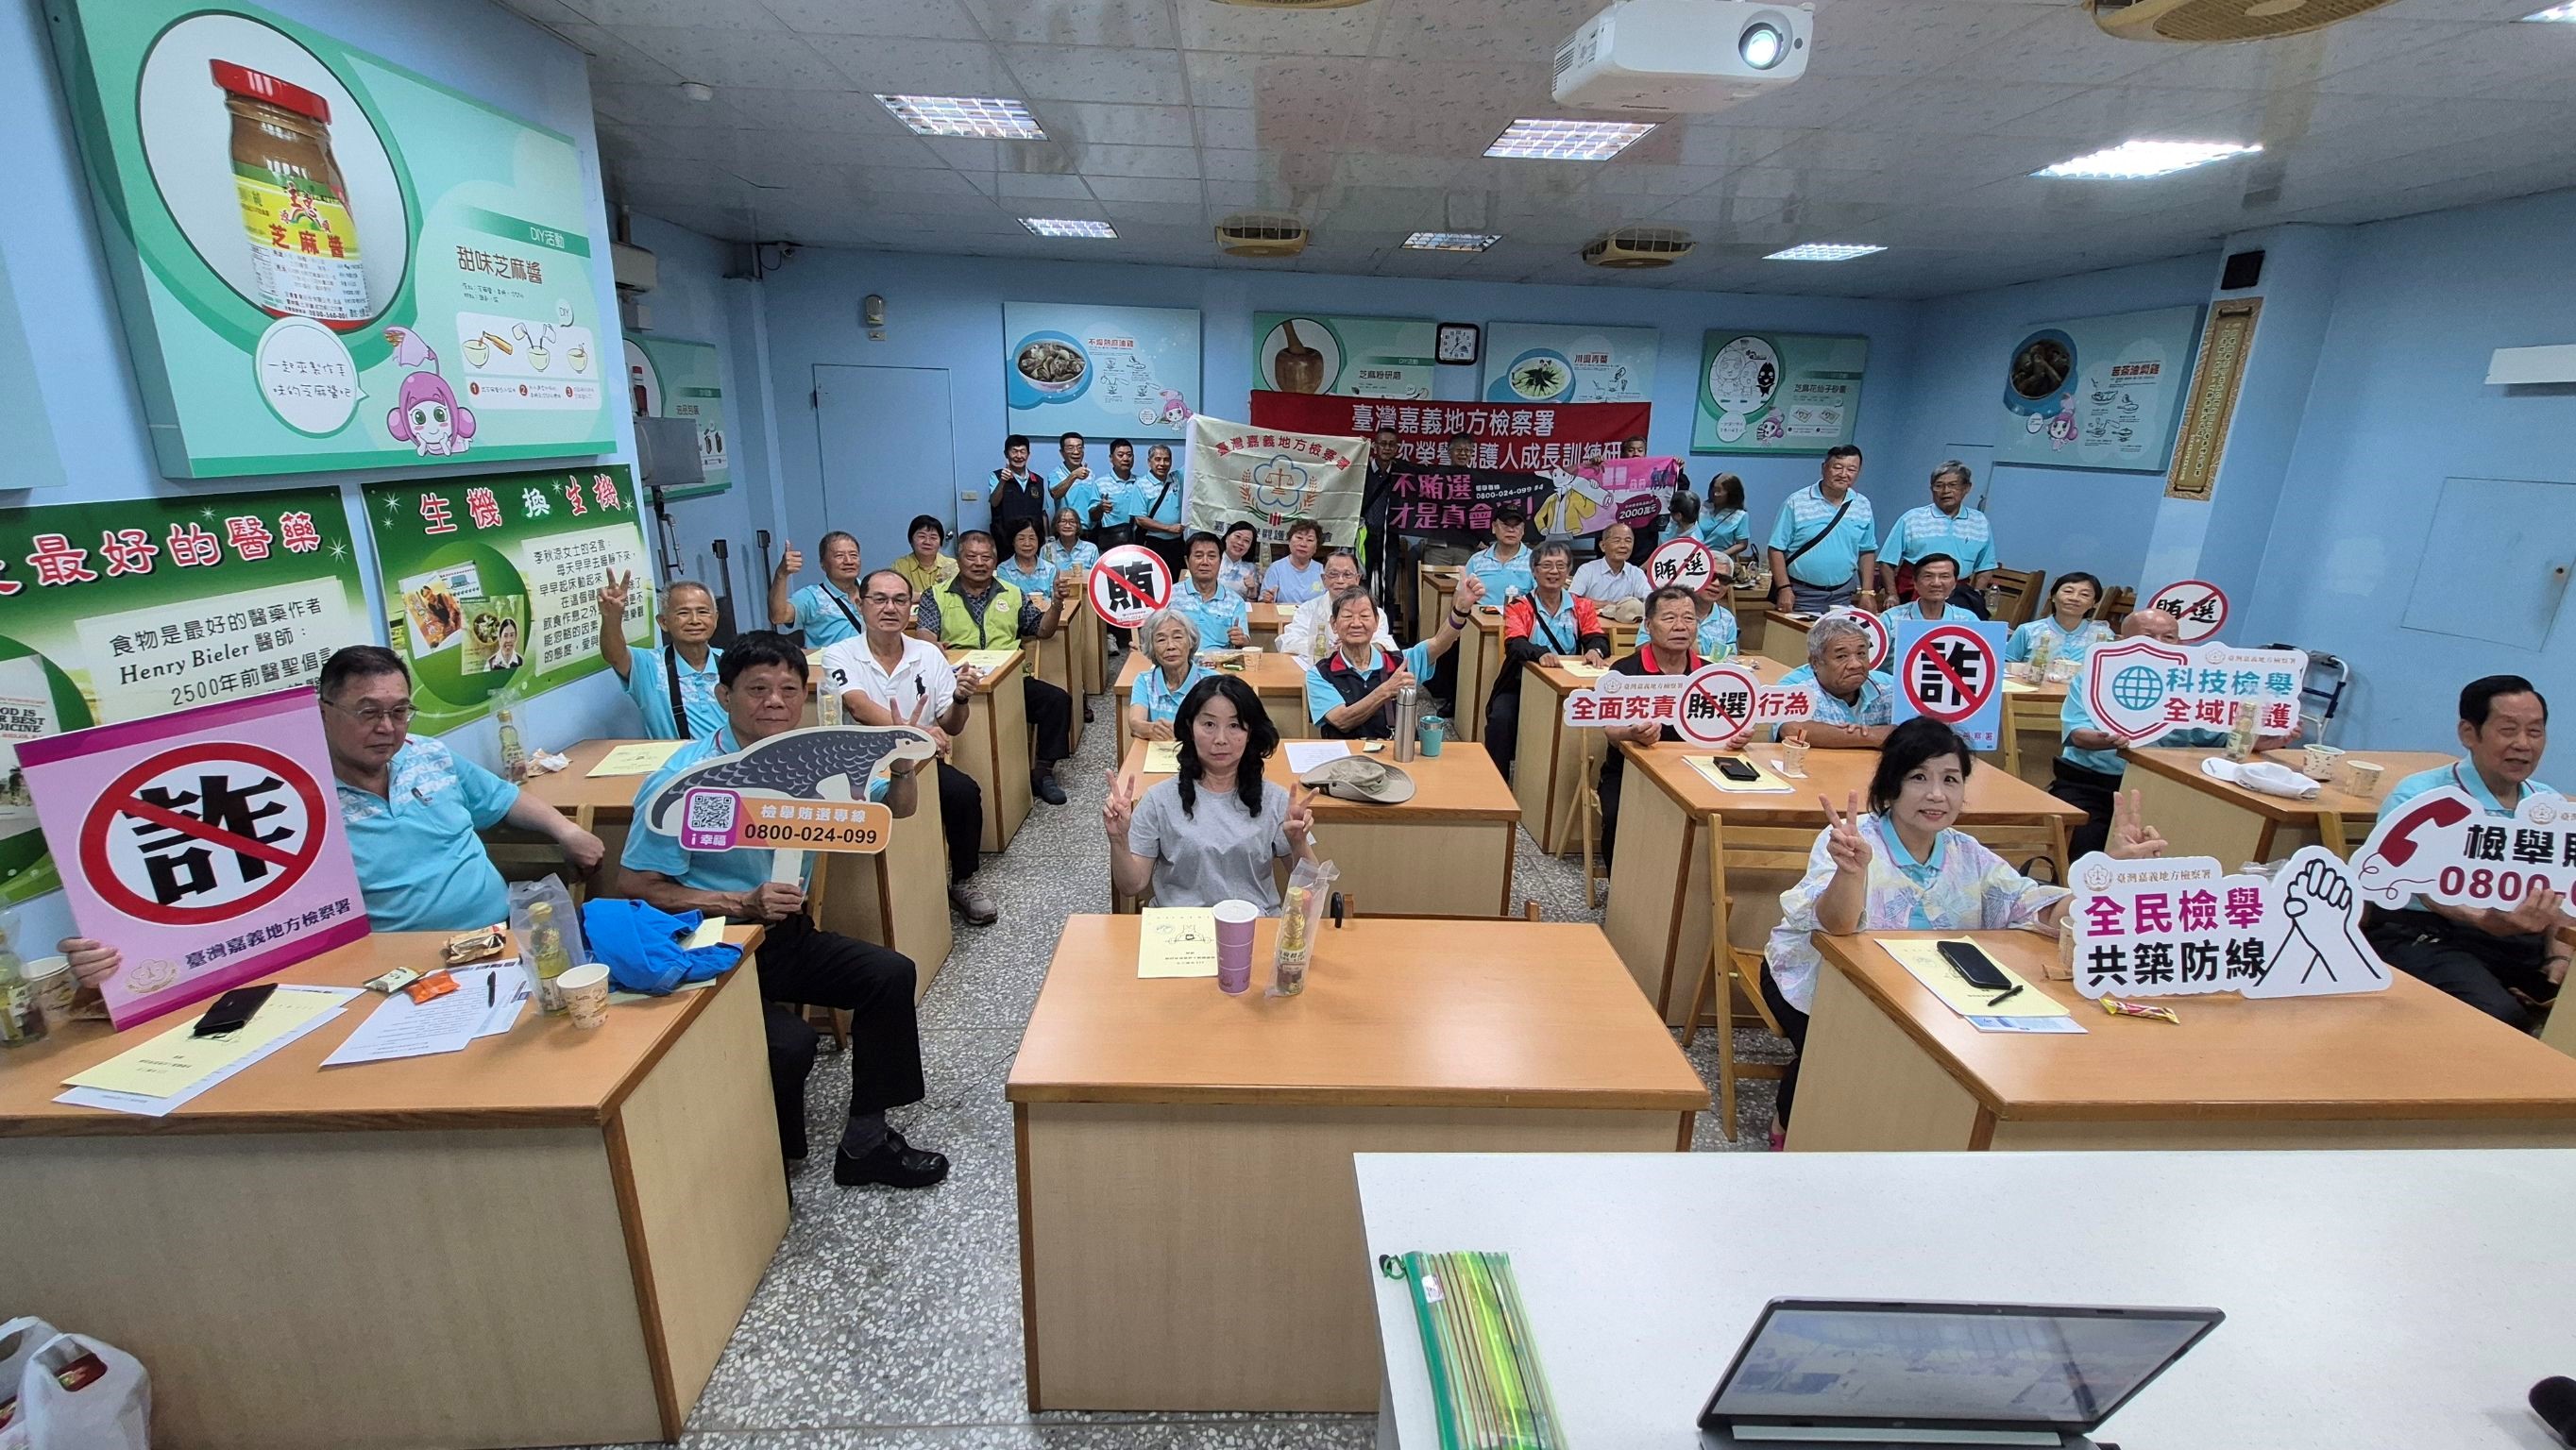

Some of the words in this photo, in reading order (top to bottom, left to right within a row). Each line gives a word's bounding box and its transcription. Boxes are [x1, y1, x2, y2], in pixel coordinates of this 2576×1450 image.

[268, 223, 345, 259] 芝麻醬
[530, 227, 566, 248] DIY活動
[456, 244, 543, 284] 甜味芝麻醬
[1352, 404, 1555, 437] 臺灣嘉義地方檢察署
[1215, 434, 1351, 472] 臺灣嘉義地方檢察署
[1391, 471, 1472, 501] 不賄選
[1476, 486, 1532, 499] 0800-024-099
[1389, 496, 1534, 531] 才是真會!
[0, 511, 321, 596] 最好的醫藥
[1654, 552, 1708, 581] 賄選
[1107, 561, 1156, 612] 賄
[109, 597, 322, 657] 食物是最好的醫藥作者
[120, 658, 186, 685] Henry
[192, 643, 250, 668] Bieler
[831, 668, 848, 686] 3
[1920, 641, 1981, 705] 詐
[2166, 667, 2294, 698] 科技檢舉
[11, 717, 45, 725] BEST
[1571, 695, 1677, 720] 全面究責
[1686, 691, 1748, 719] 賄選
[1758, 691, 1809, 717] 行為
[761, 803, 867, 823] 檢舉賄選專線
[122, 774, 296, 906] 詐
[744, 824, 877, 845] 0800-024-099
[2116, 868, 2212, 885] 臺灣嘉義地方檢察署
[2439, 866, 2576, 907] 0800-
[2084, 886, 2264, 937] 全民檢舉
[184, 897, 351, 970] 臺灣嘉義地方檢察署
[2087, 936, 2266, 986] 共築防線
